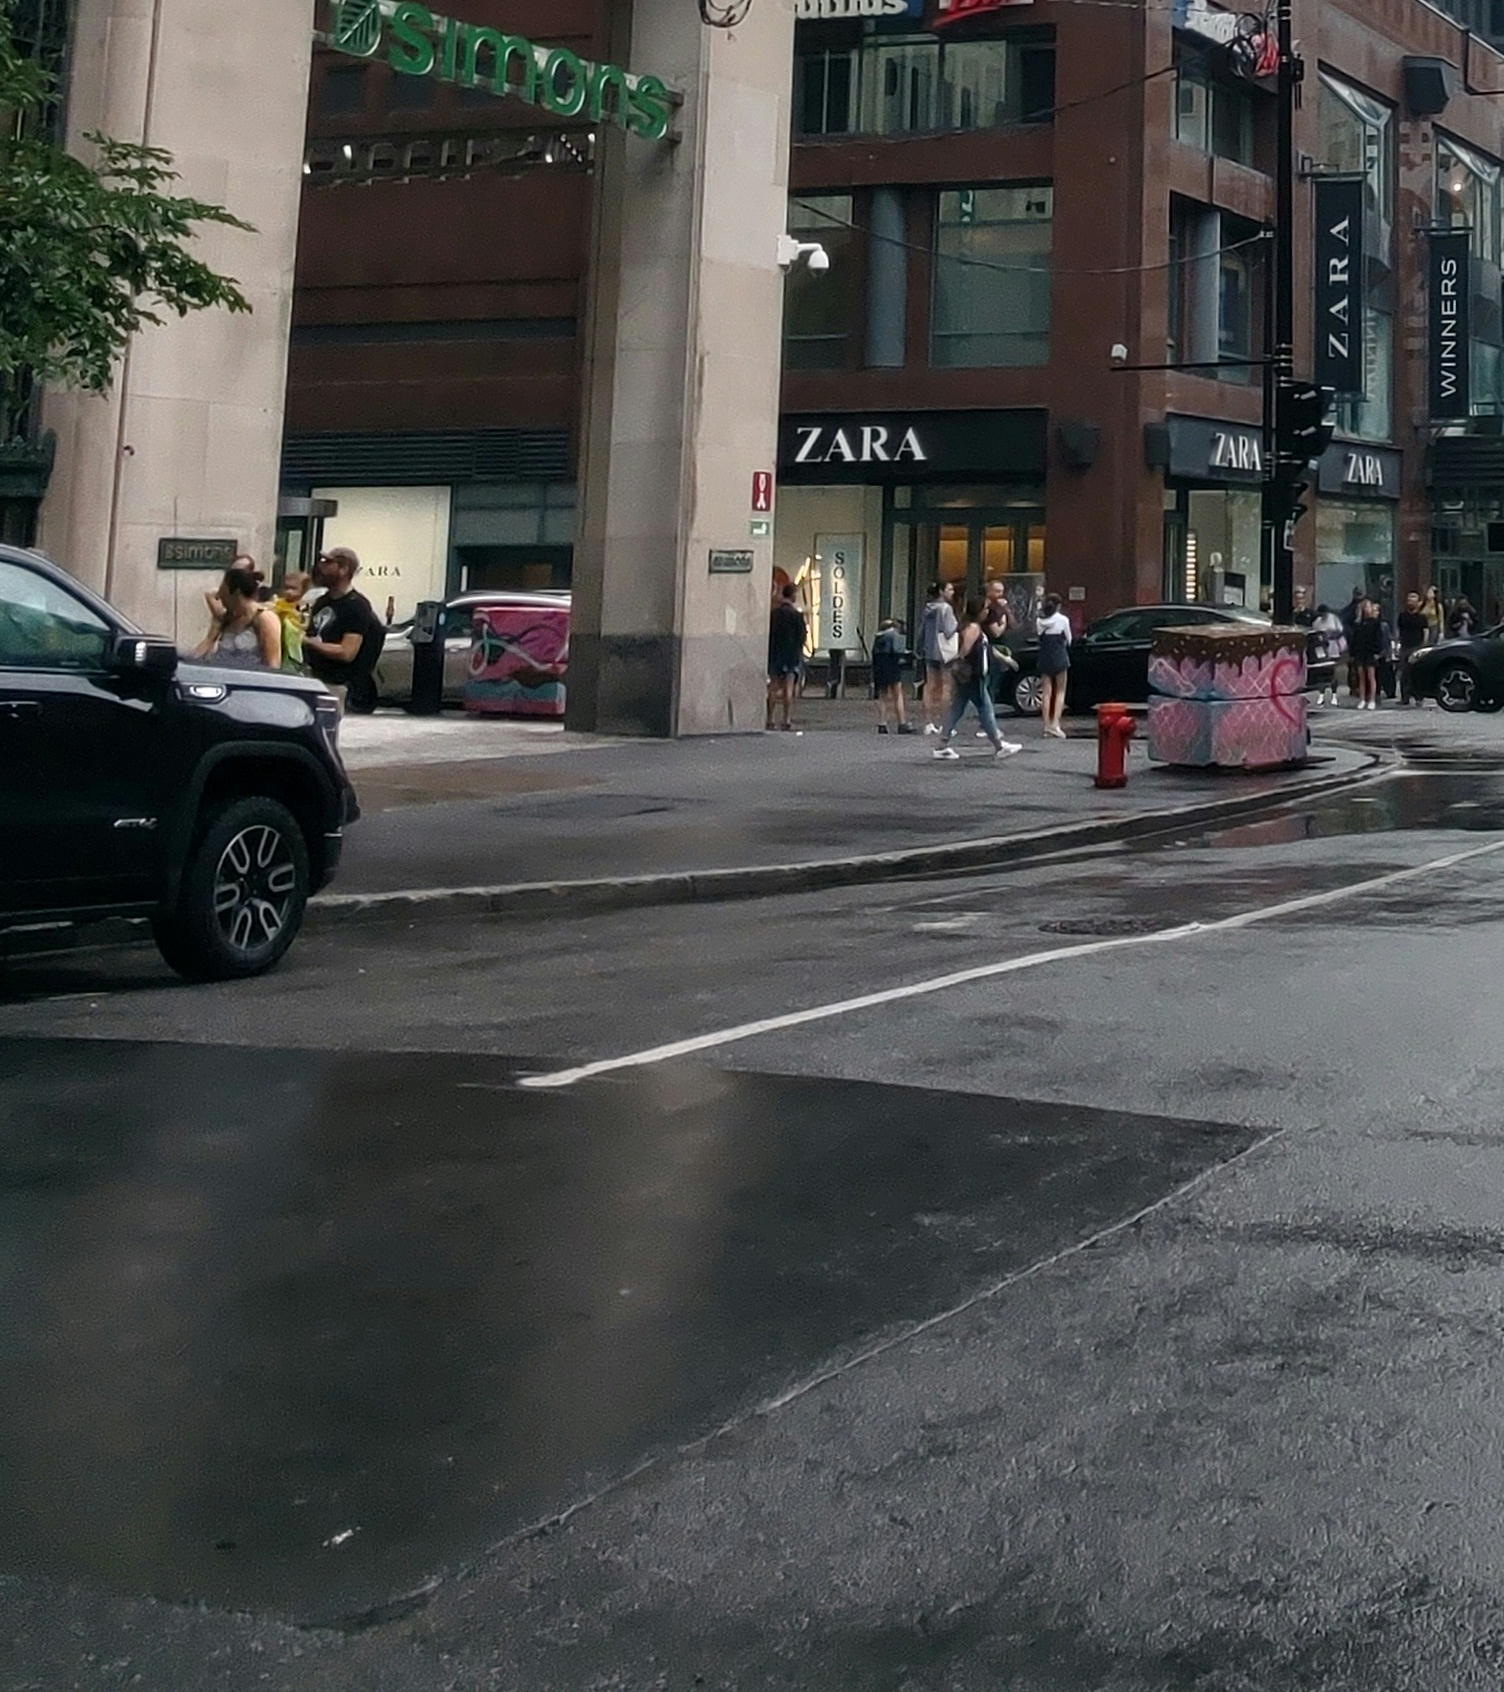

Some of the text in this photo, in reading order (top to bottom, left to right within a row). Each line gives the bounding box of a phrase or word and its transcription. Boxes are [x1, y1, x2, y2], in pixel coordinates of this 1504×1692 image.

[387, 0, 668, 140] simons
[1328, 215, 1349, 359] ZARA
[1440, 258, 1458, 398] WINNERS
[796, 426, 927, 463] ZARA
[1211, 433, 1262, 471] ZARA
[1347, 453, 1383, 486] ZARA
[832, 551, 845, 638] SOLDES
